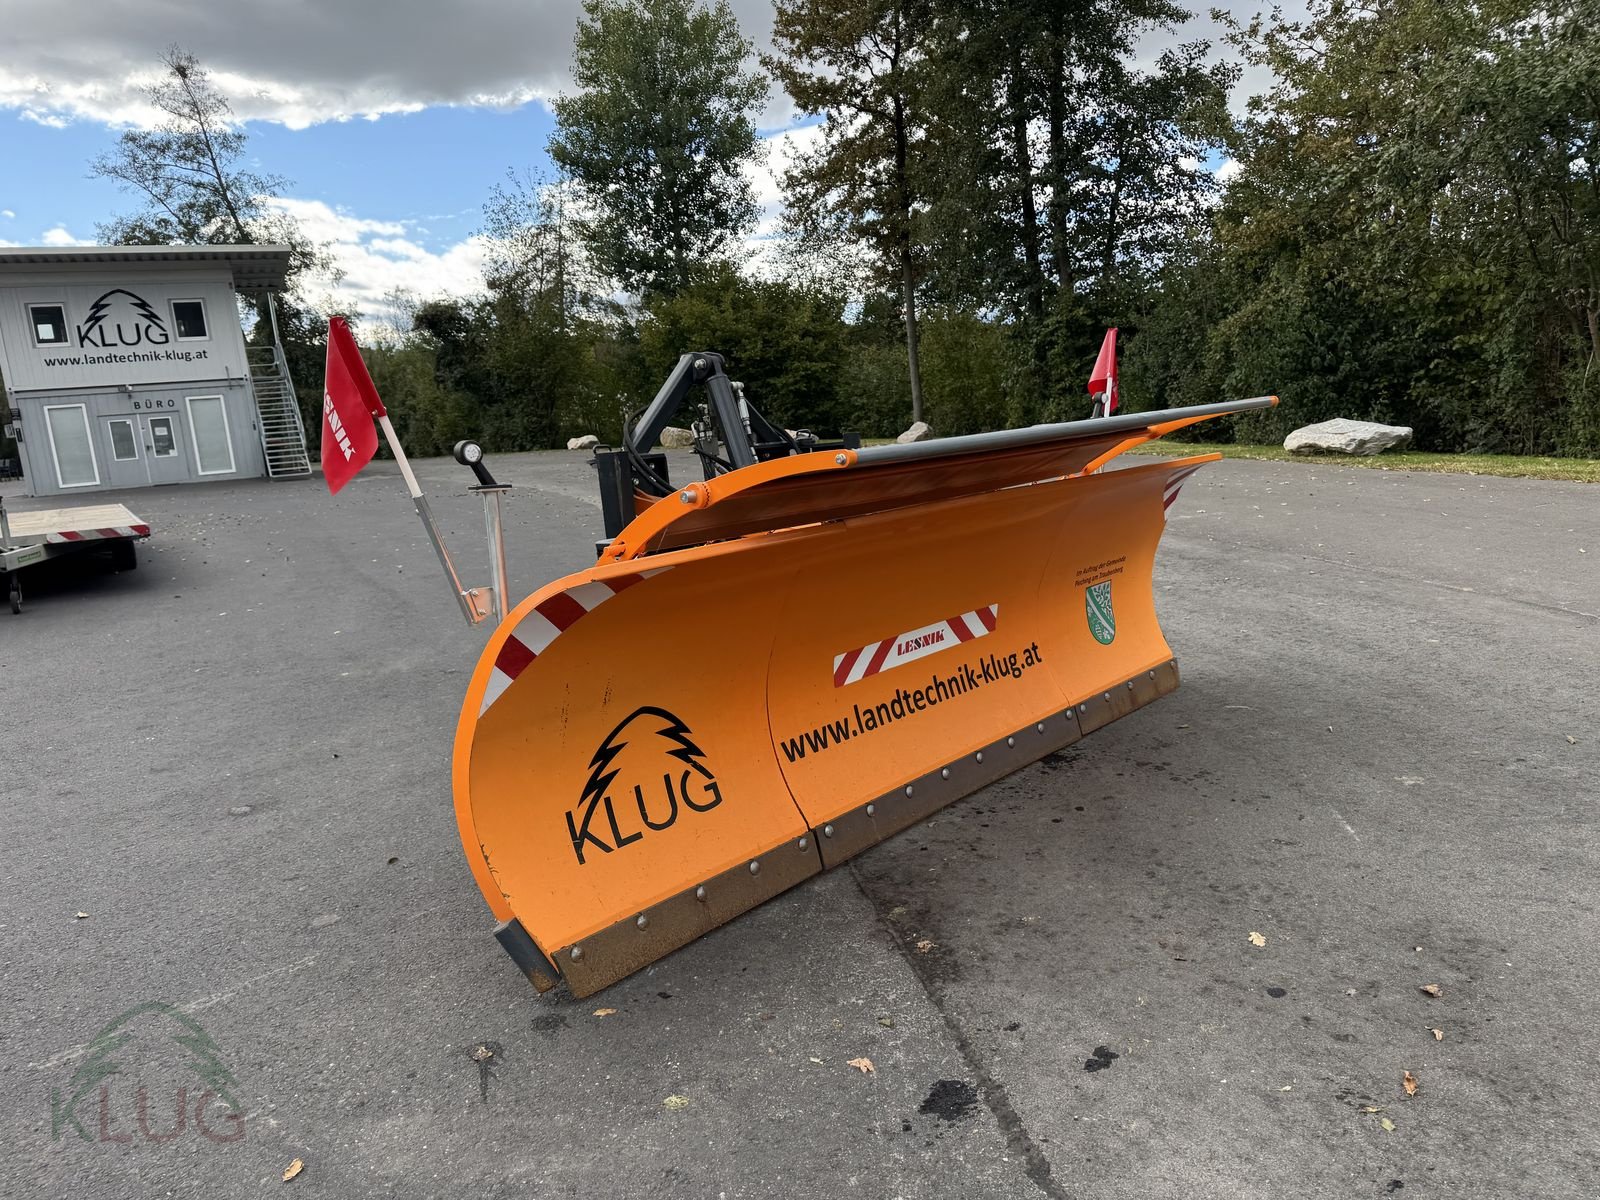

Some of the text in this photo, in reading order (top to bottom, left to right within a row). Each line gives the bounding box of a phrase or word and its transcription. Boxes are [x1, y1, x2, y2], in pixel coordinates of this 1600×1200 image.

[76, 322, 169, 349] KLUG
[44, 349, 208, 367] www.landtechnik-klug.at
[134, 399, 175, 410] BÜRO
[324, 388, 356, 463] SNIK
[897, 629, 945, 656] LESNIK
[780, 641, 1043, 763] www.landtechnik-klug.at
[565, 769, 723, 865] KLUG
